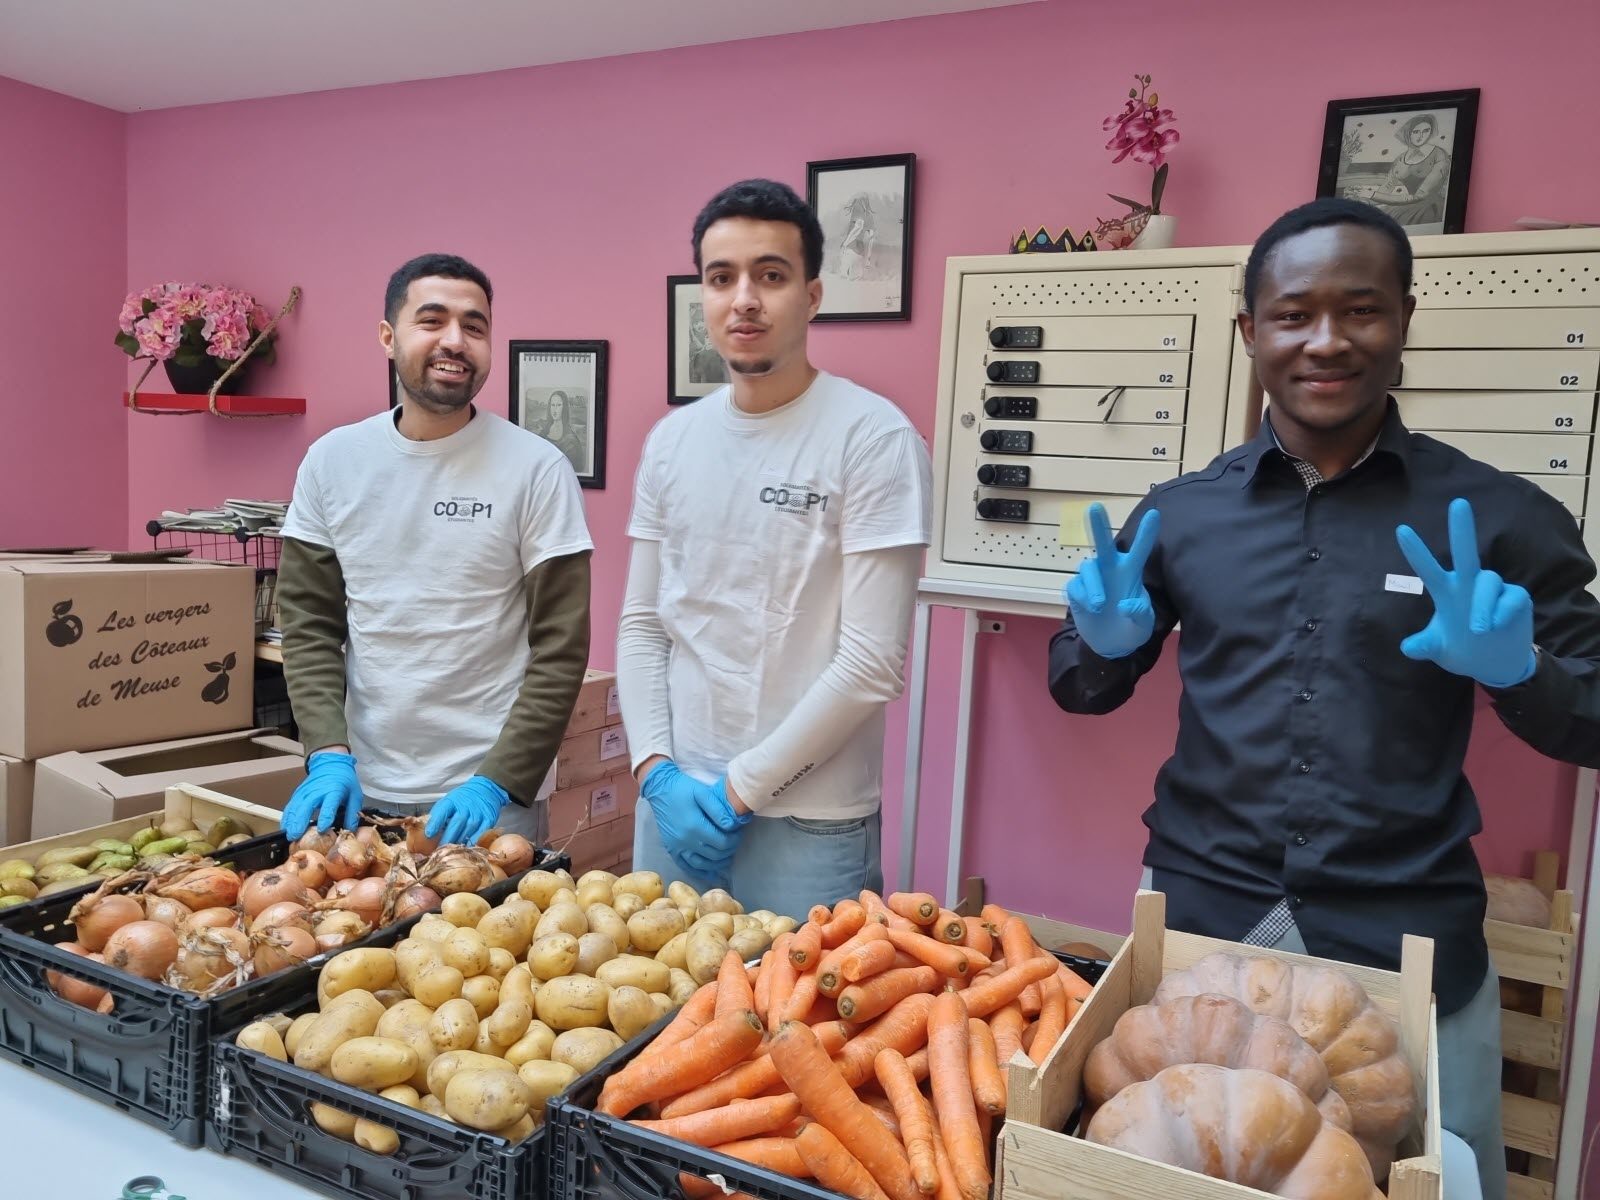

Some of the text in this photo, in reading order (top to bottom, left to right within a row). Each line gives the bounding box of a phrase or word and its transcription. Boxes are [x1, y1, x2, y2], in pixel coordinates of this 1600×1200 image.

[1163, 337, 1177, 346] 01
[1566, 333, 1584, 344] 01
[1159, 374, 1174, 383] 02
[1560, 376, 1579, 386] 02
[1155, 411, 1169, 420] 03
[1555, 417, 1573, 427] 03
[1152, 446, 1167, 456] 04
[1549, 459, 1568, 469] 04
[97, 602, 211, 633] Les vergers
[88, 635, 210, 670] des Côteaux
[76, 674, 181, 709] de Meuse
